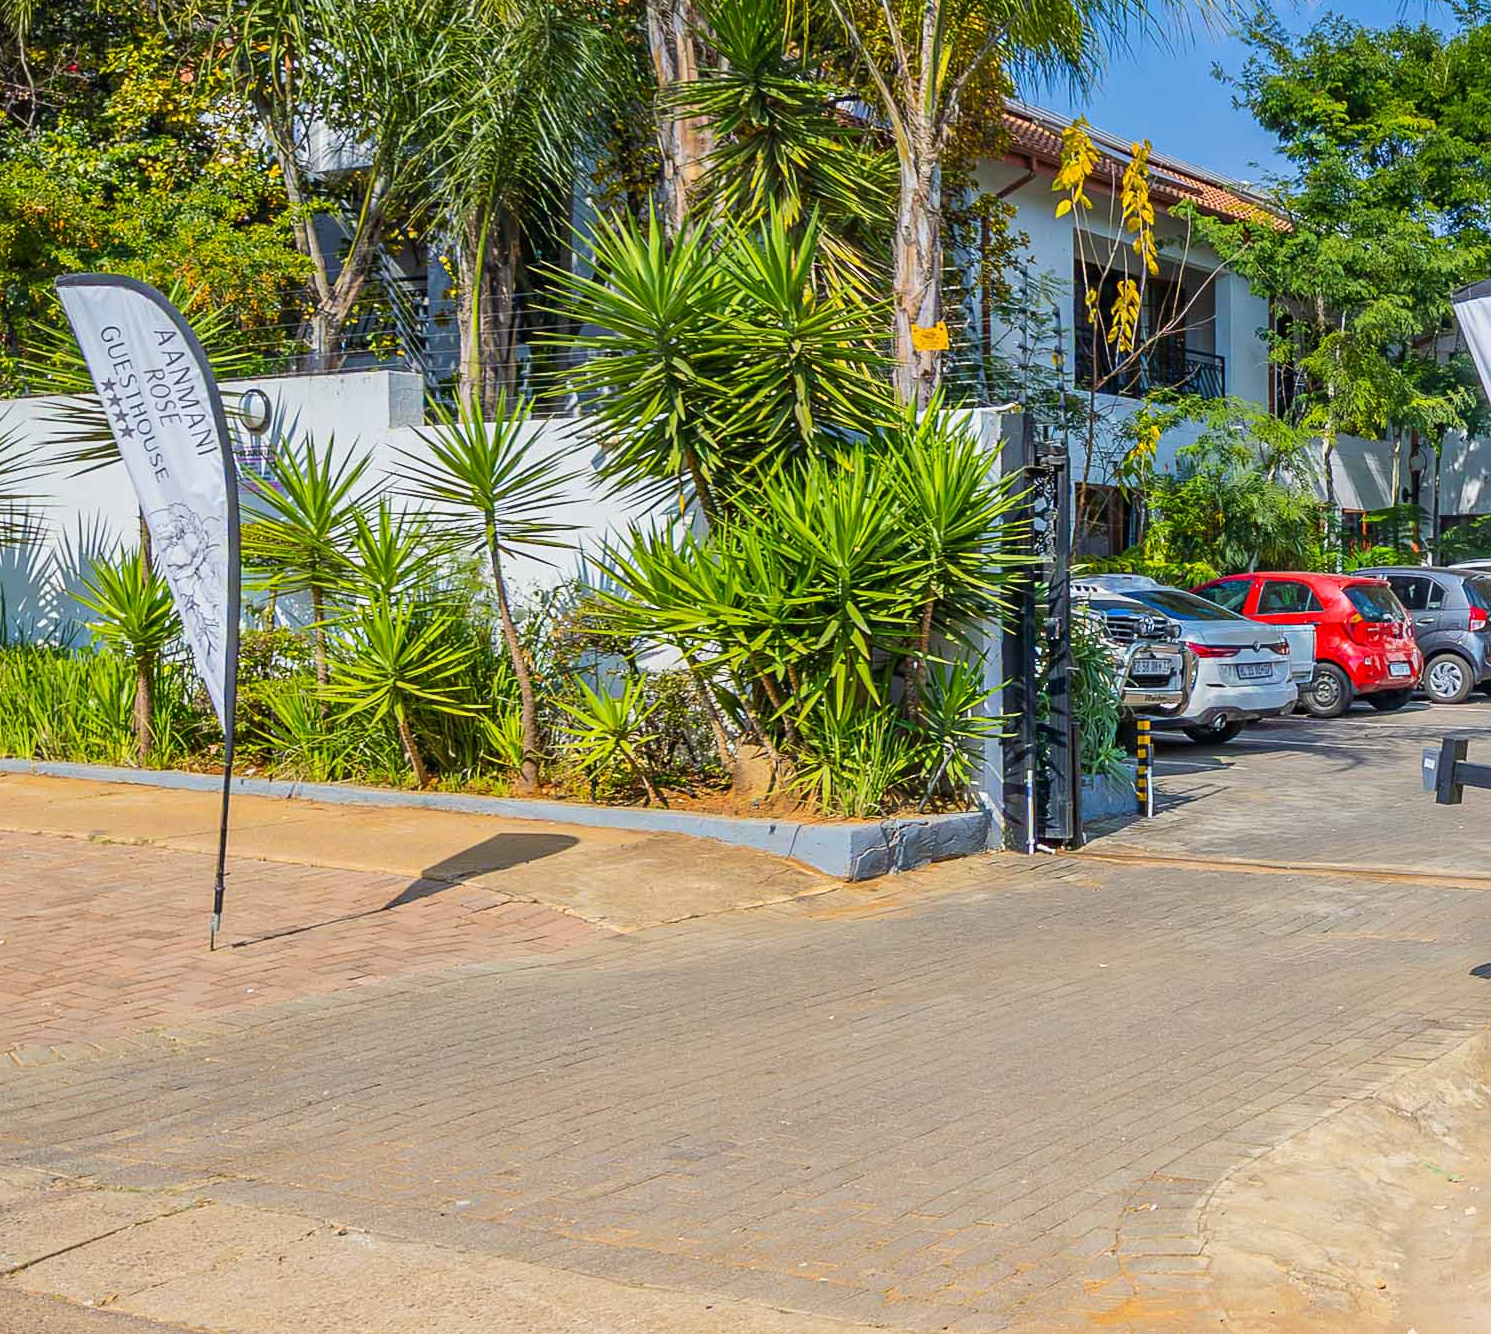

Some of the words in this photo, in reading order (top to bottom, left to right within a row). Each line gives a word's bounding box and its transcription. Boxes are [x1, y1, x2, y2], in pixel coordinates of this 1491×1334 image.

[100, 326, 170, 483] GUESTHOUSE
[144, 368, 182, 427] ROSE
[153, 330, 218, 456] AANMANI
